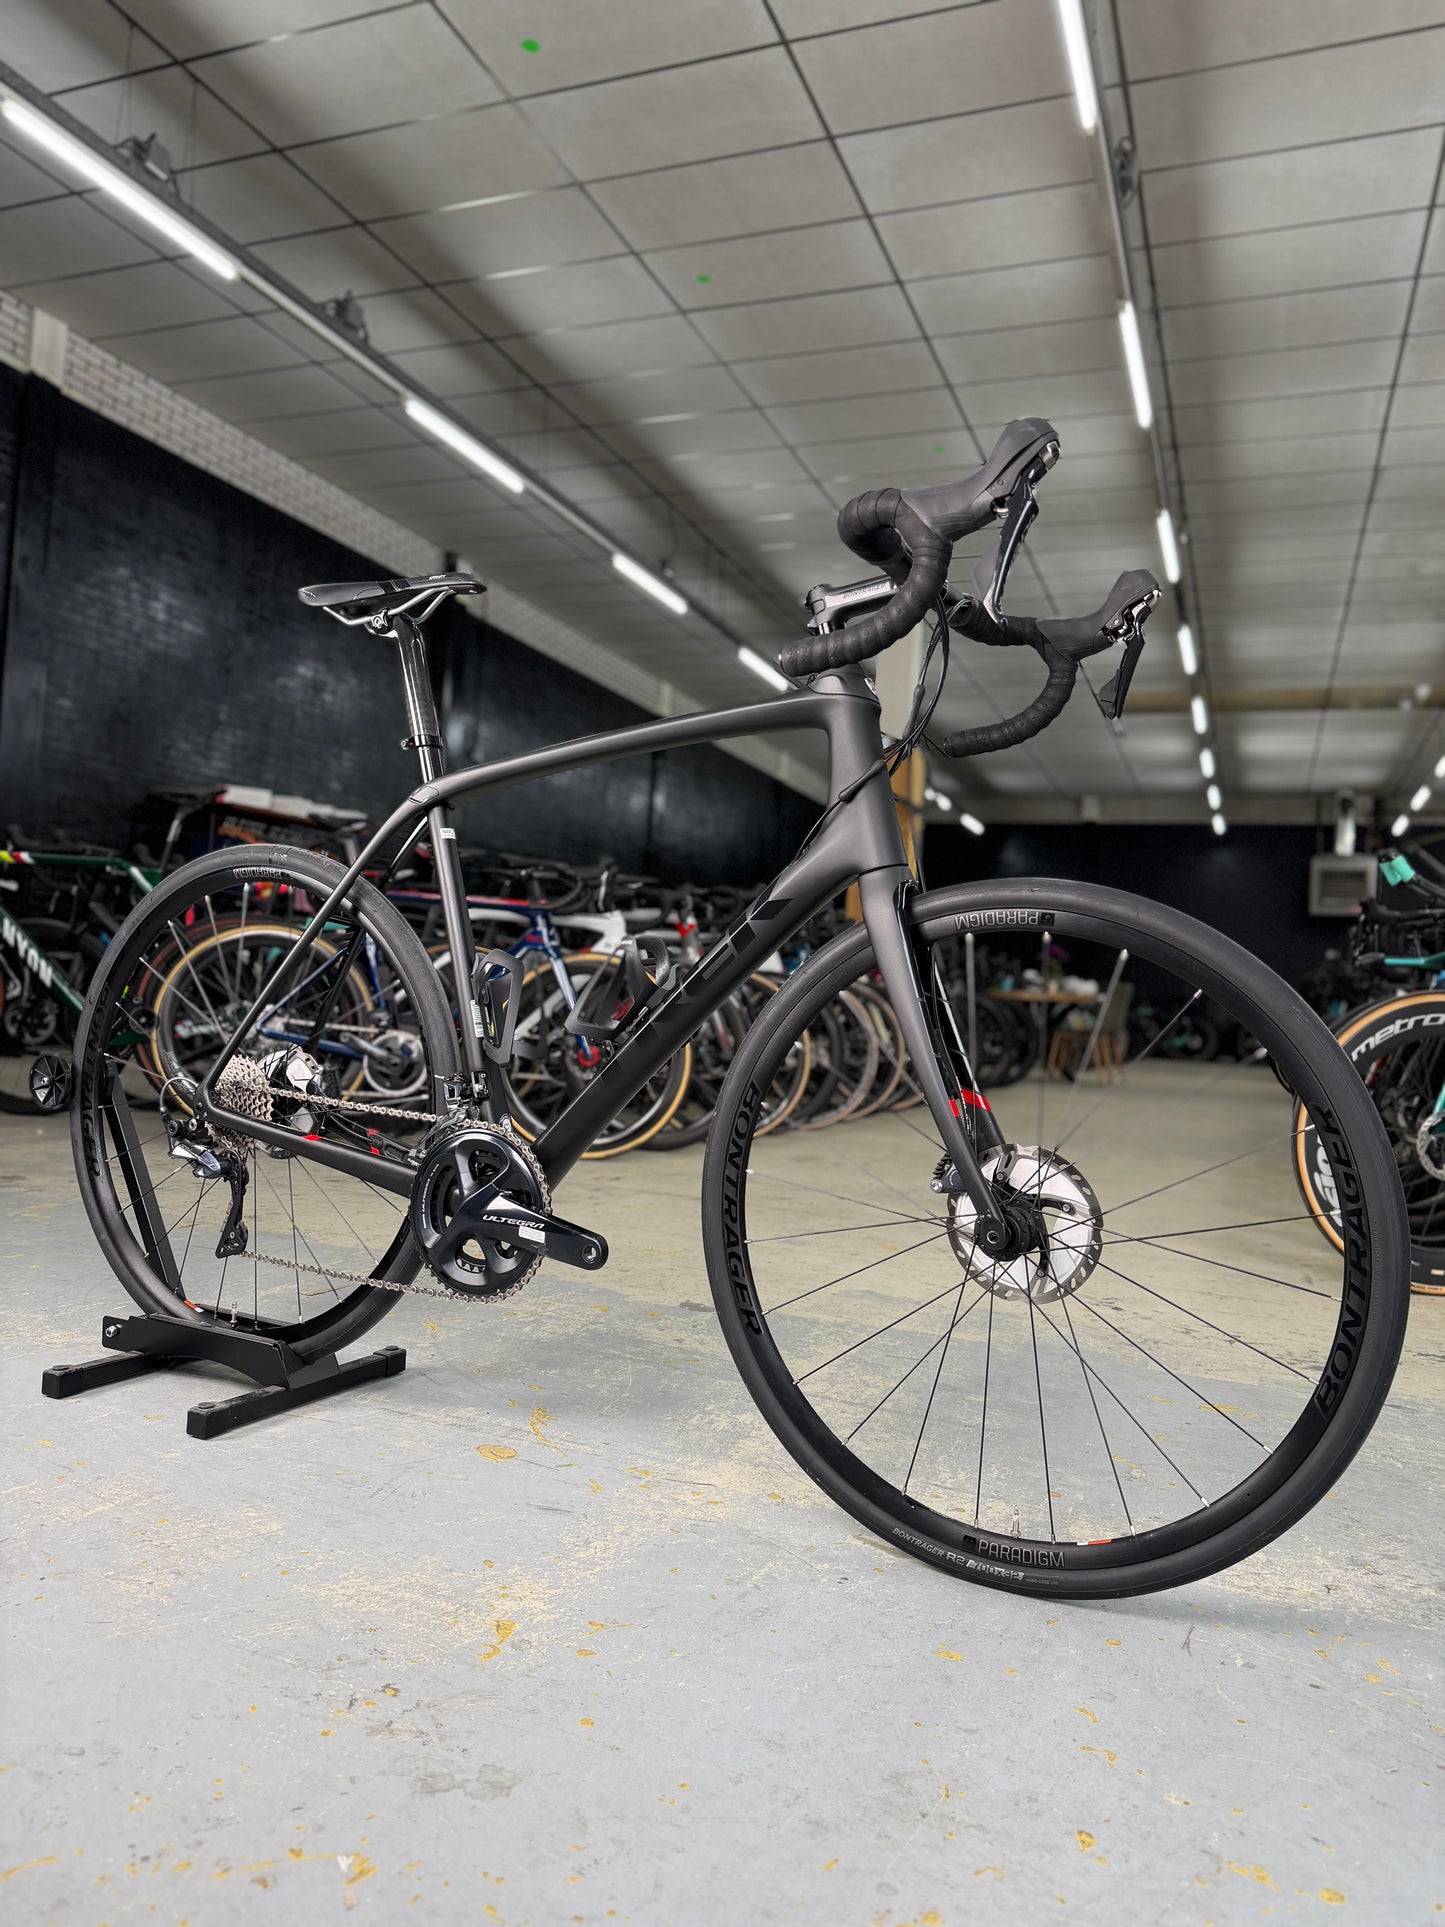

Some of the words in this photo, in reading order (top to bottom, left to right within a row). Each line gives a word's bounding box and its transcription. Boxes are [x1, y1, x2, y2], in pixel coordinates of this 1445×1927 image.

[842, 583, 886, 599] BONTRAGER
[232, 866, 282, 879] PARADIGM
[955, 911, 1039, 930] PARADIGM
[81, 983, 114, 1177] BONTRAGER
[482, 1214, 545, 1229] ULTEGRA
[723, 1080, 764, 1335] BONTRAGER
[1308, 1102, 1369, 1417] BONTRAGER
[892, 1527, 945, 1557] BONTRAGER
[946, 1551, 966, 1565] R2
[978, 1539, 1065, 1567] PARADIGM
